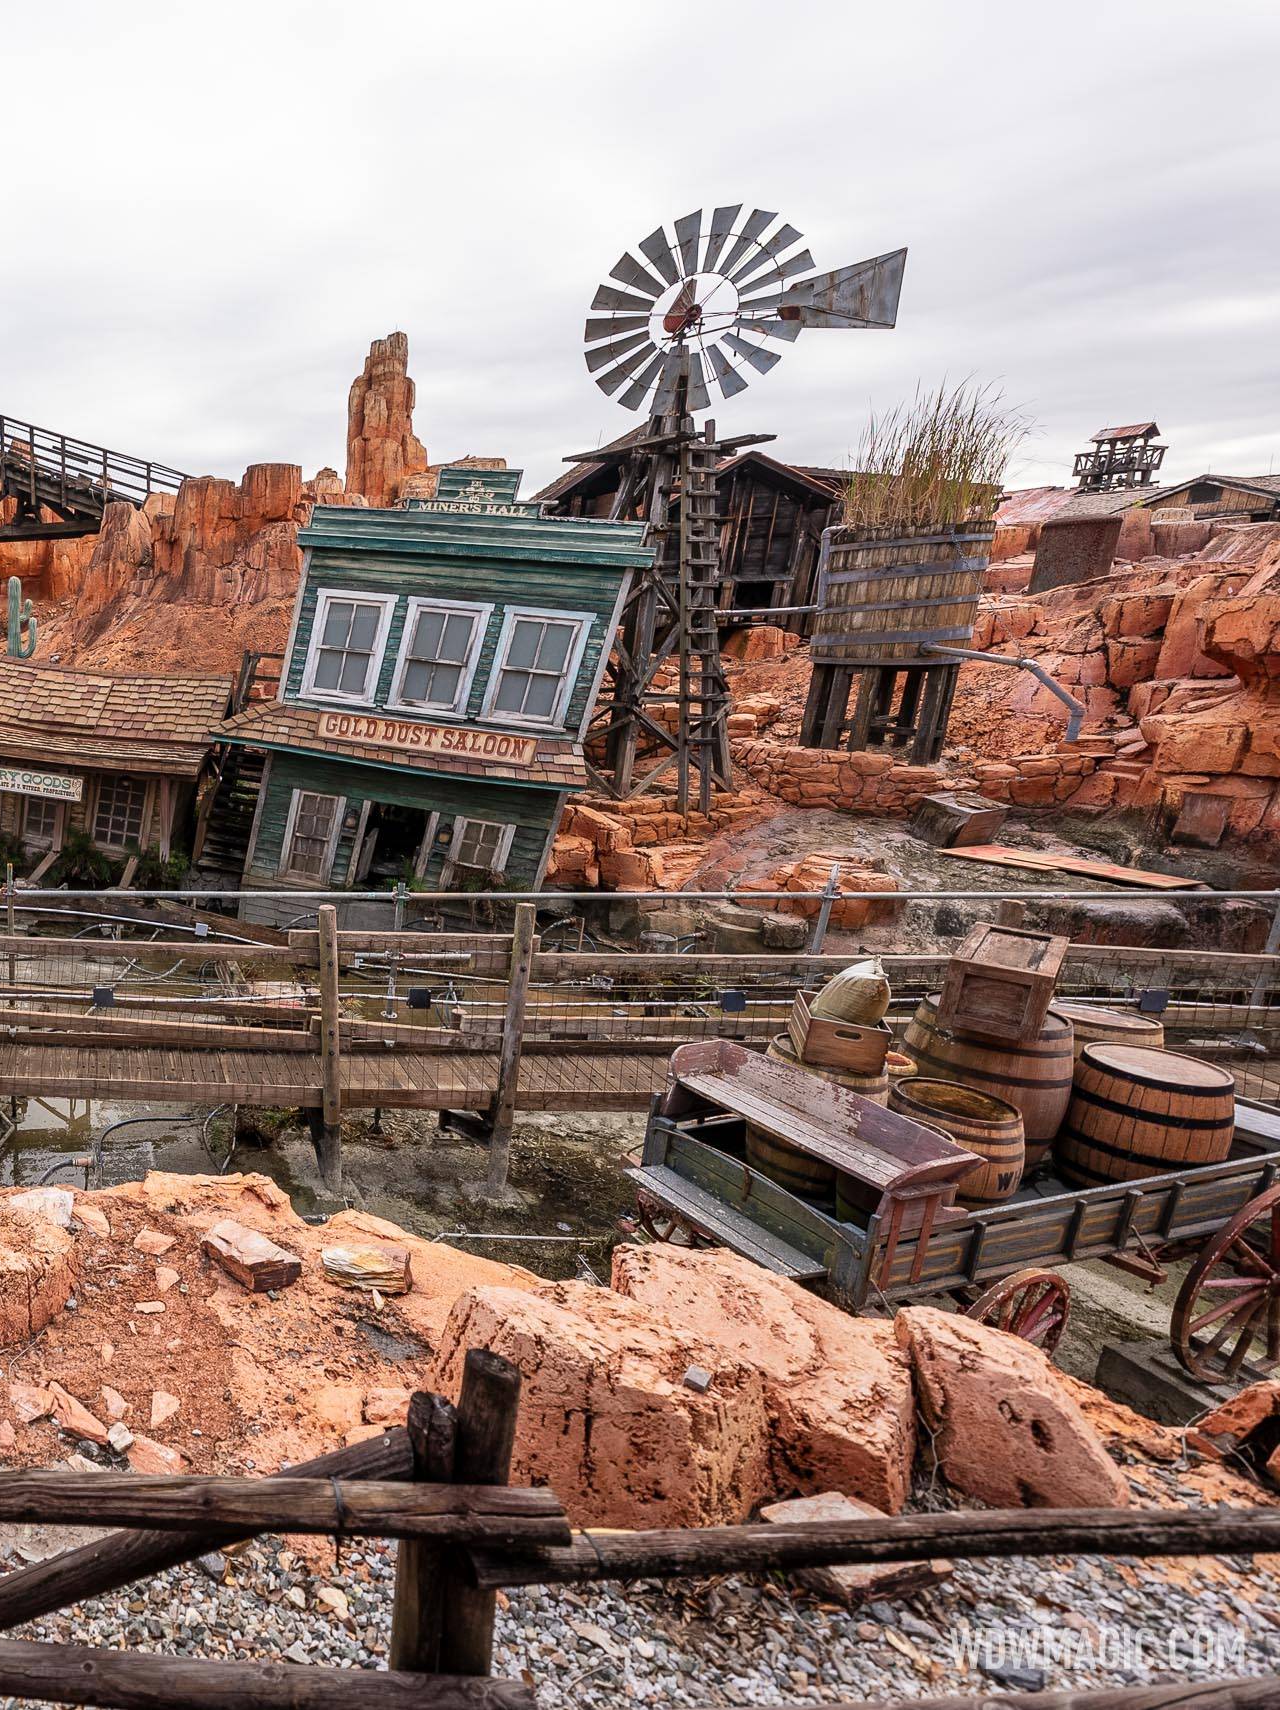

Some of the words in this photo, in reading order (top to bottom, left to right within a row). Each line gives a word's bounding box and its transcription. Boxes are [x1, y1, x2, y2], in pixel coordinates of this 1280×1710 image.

[418, 501, 481, 514] MINER'S
[485, 504, 528, 516] HALL
[325, 715, 378, 739] GOLD
[381, 721, 438, 748] DUST
[440, 729, 529, 760] SALOON
[21, 773, 72, 790] GOODS
